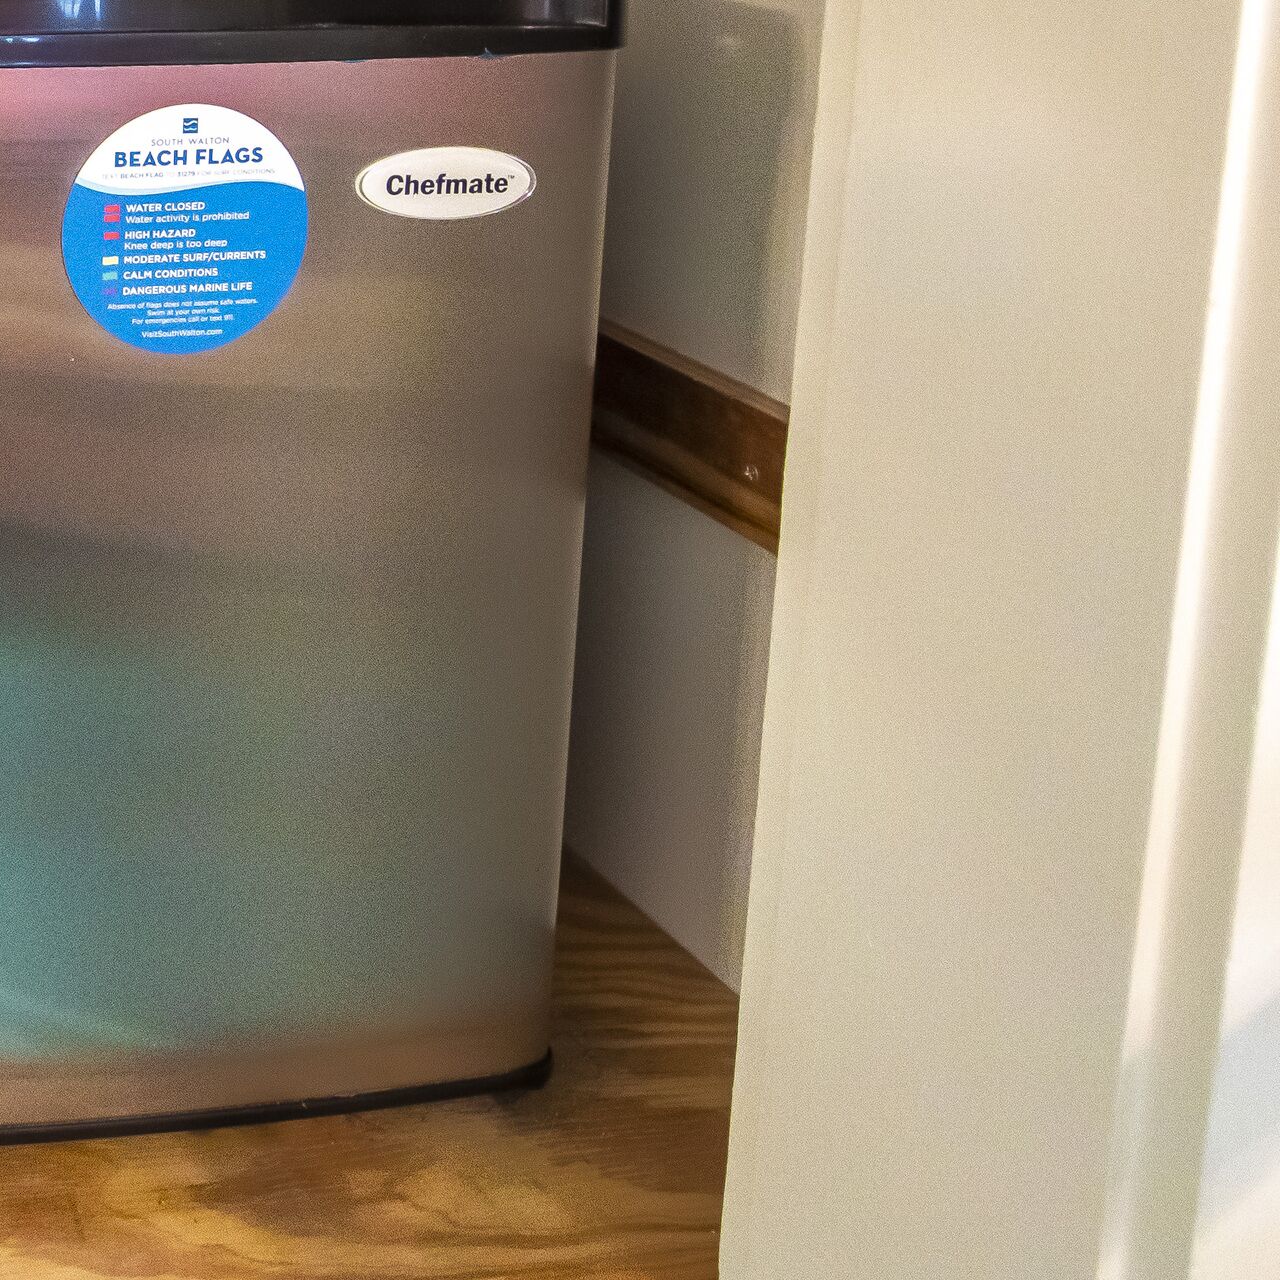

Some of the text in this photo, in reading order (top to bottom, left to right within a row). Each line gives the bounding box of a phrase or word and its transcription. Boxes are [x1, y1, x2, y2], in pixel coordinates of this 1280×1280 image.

[152, 137, 230, 147] SOUTH WALTON
[114, 147, 263, 168] BEACH FLAGS
[386, 173, 508, 195] Chefmate
[126, 202, 205, 212] WATER CLOSED
[125, 212, 250, 223] Water activity is prohibited
[124, 229, 196, 239] HIGH HAZARD
[124, 242, 148, 250] Knee
[151, 241, 174, 250] deep
[186, 240, 202, 248] too
[204, 239, 228, 248] deep
[124, 250, 266, 264] MODERATE SURF/CURRENTS
[123, 268, 218, 280] CALM CONDITIONS
[122, 281, 252, 295] DANGEROUS MARINE LIFE
[146, 302, 162, 310] flags
[175, 309, 190, 317] your
[141, 329, 223, 338] VisitSouthWalton.com
